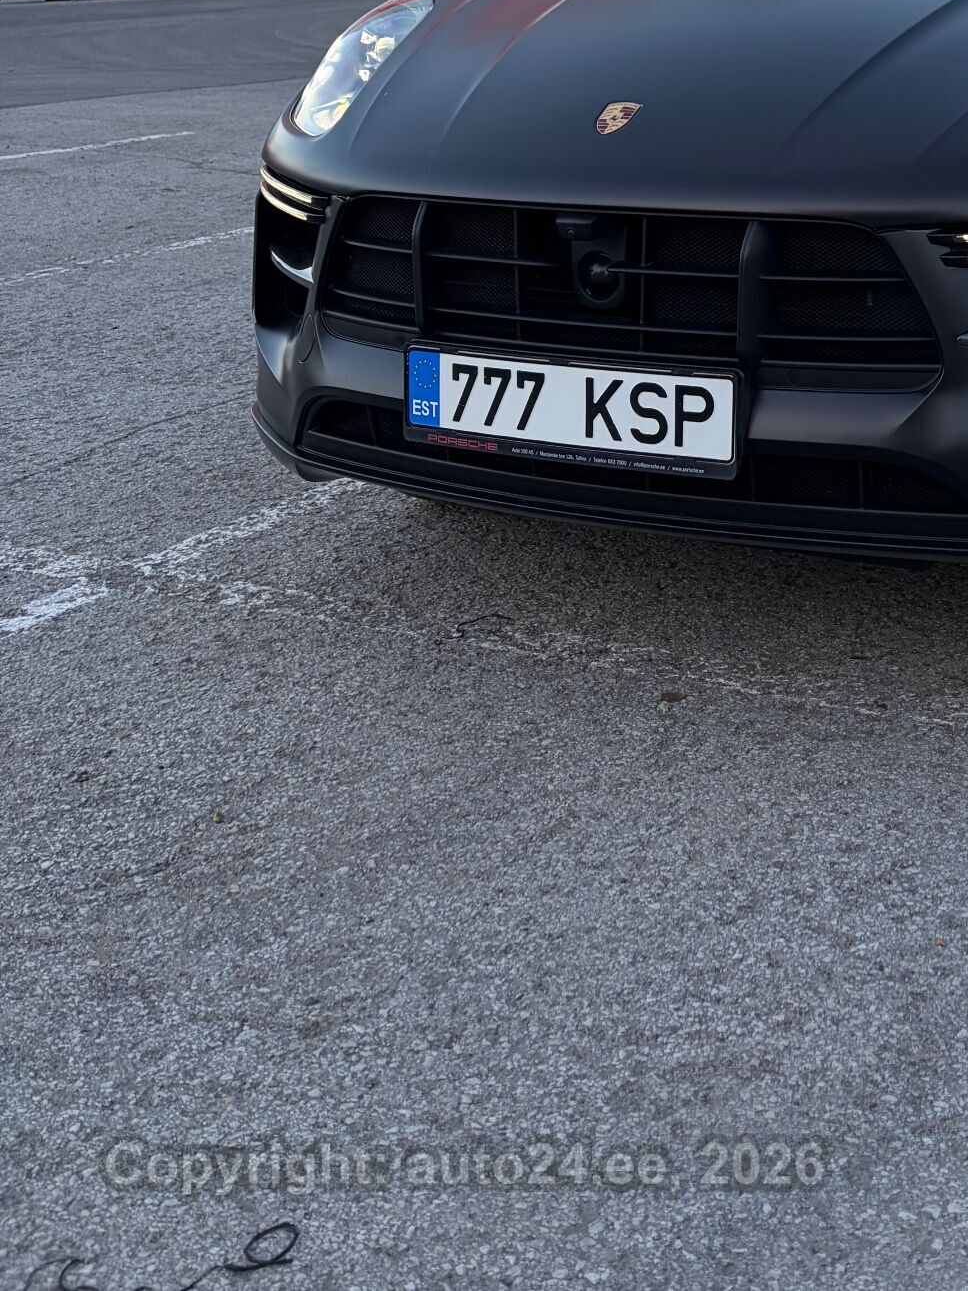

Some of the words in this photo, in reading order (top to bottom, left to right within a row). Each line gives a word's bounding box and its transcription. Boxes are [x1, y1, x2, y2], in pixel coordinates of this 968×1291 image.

[412, 398, 439, 418] EST
[452, 363, 545, 431] 777
[584, 376, 715, 448] KSP
[427, 434, 499, 451] PORSCHE
